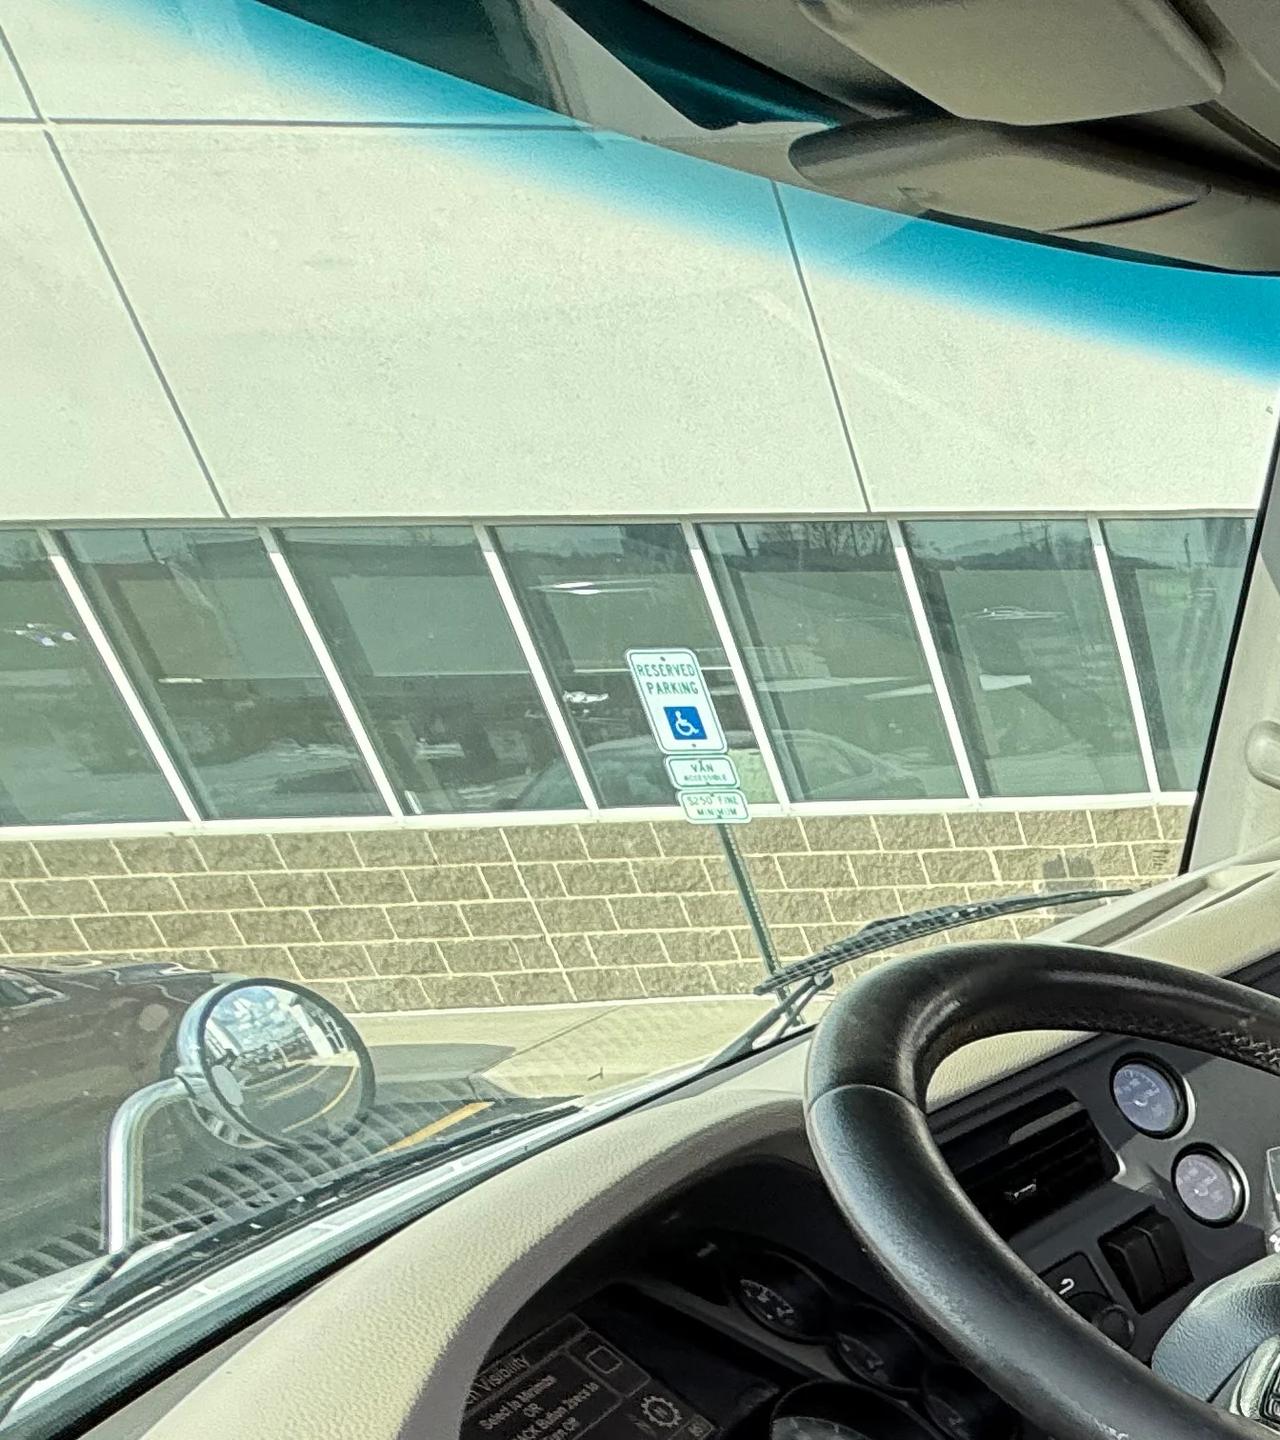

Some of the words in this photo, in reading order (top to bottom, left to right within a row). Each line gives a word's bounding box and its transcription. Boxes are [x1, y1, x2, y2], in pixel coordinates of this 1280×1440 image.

[636, 664, 695, 677] RESERVED
[646, 682, 699, 695] PARKING
[690, 764, 714, 773] VAN
